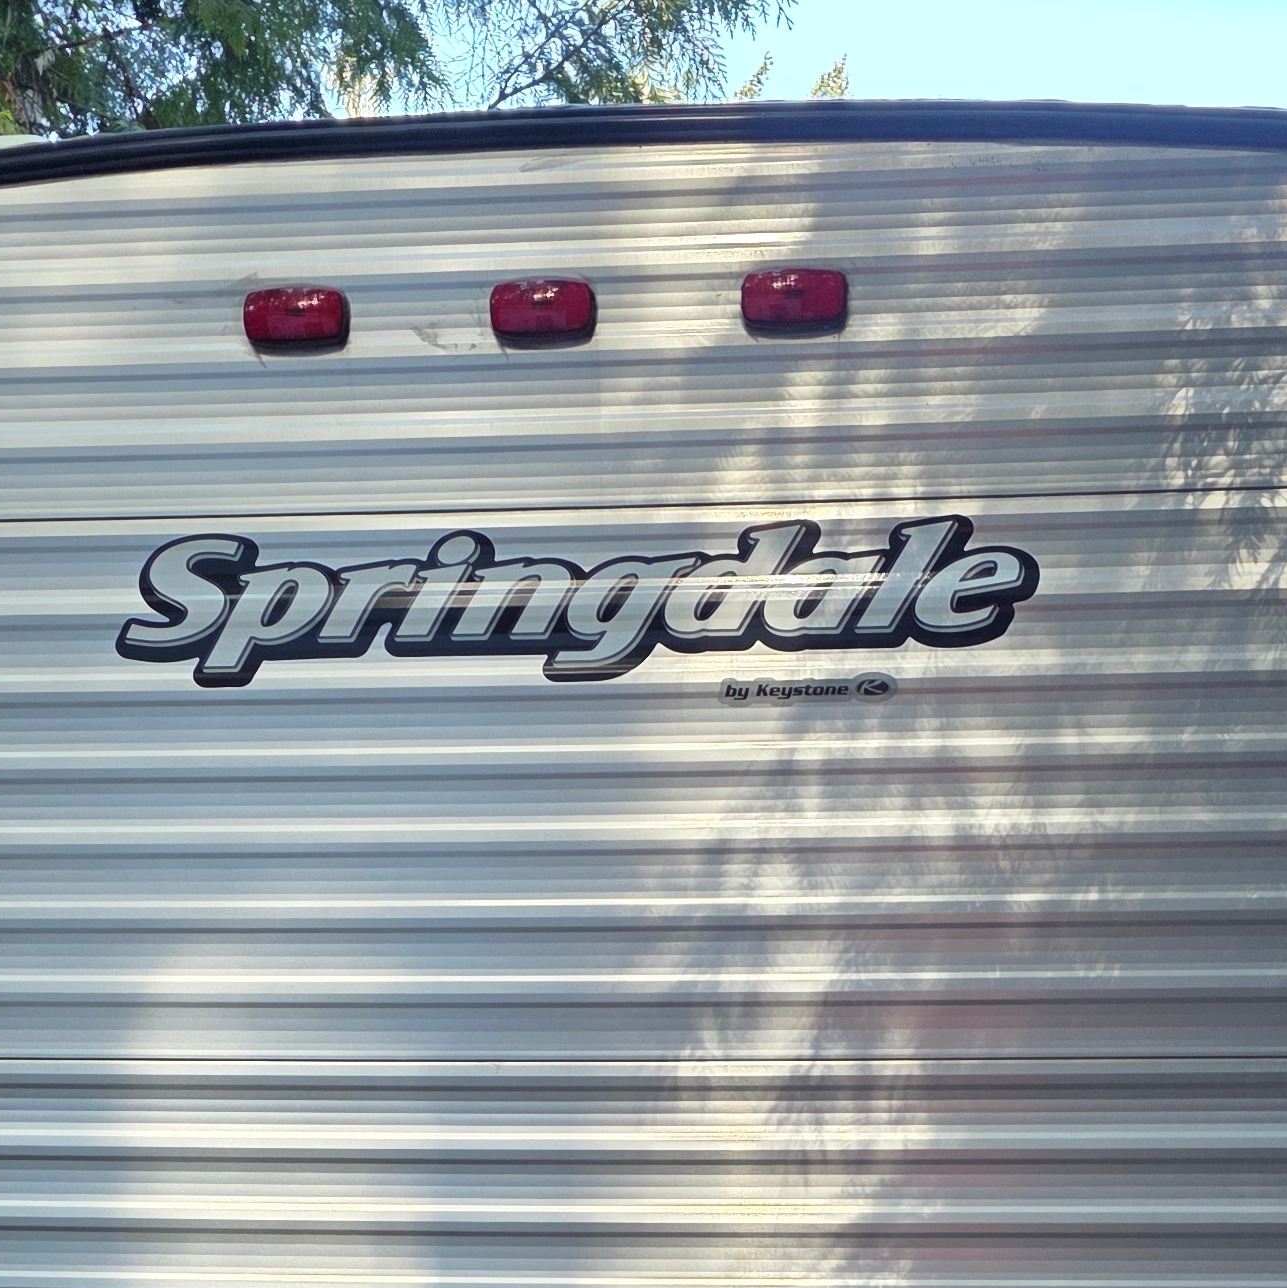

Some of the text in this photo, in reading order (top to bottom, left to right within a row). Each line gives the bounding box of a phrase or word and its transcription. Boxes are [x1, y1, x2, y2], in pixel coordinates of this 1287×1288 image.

[115, 514, 1040, 687] Springdale
[724, 684, 750, 700] by
[755, 683, 849, 700] Keystone
